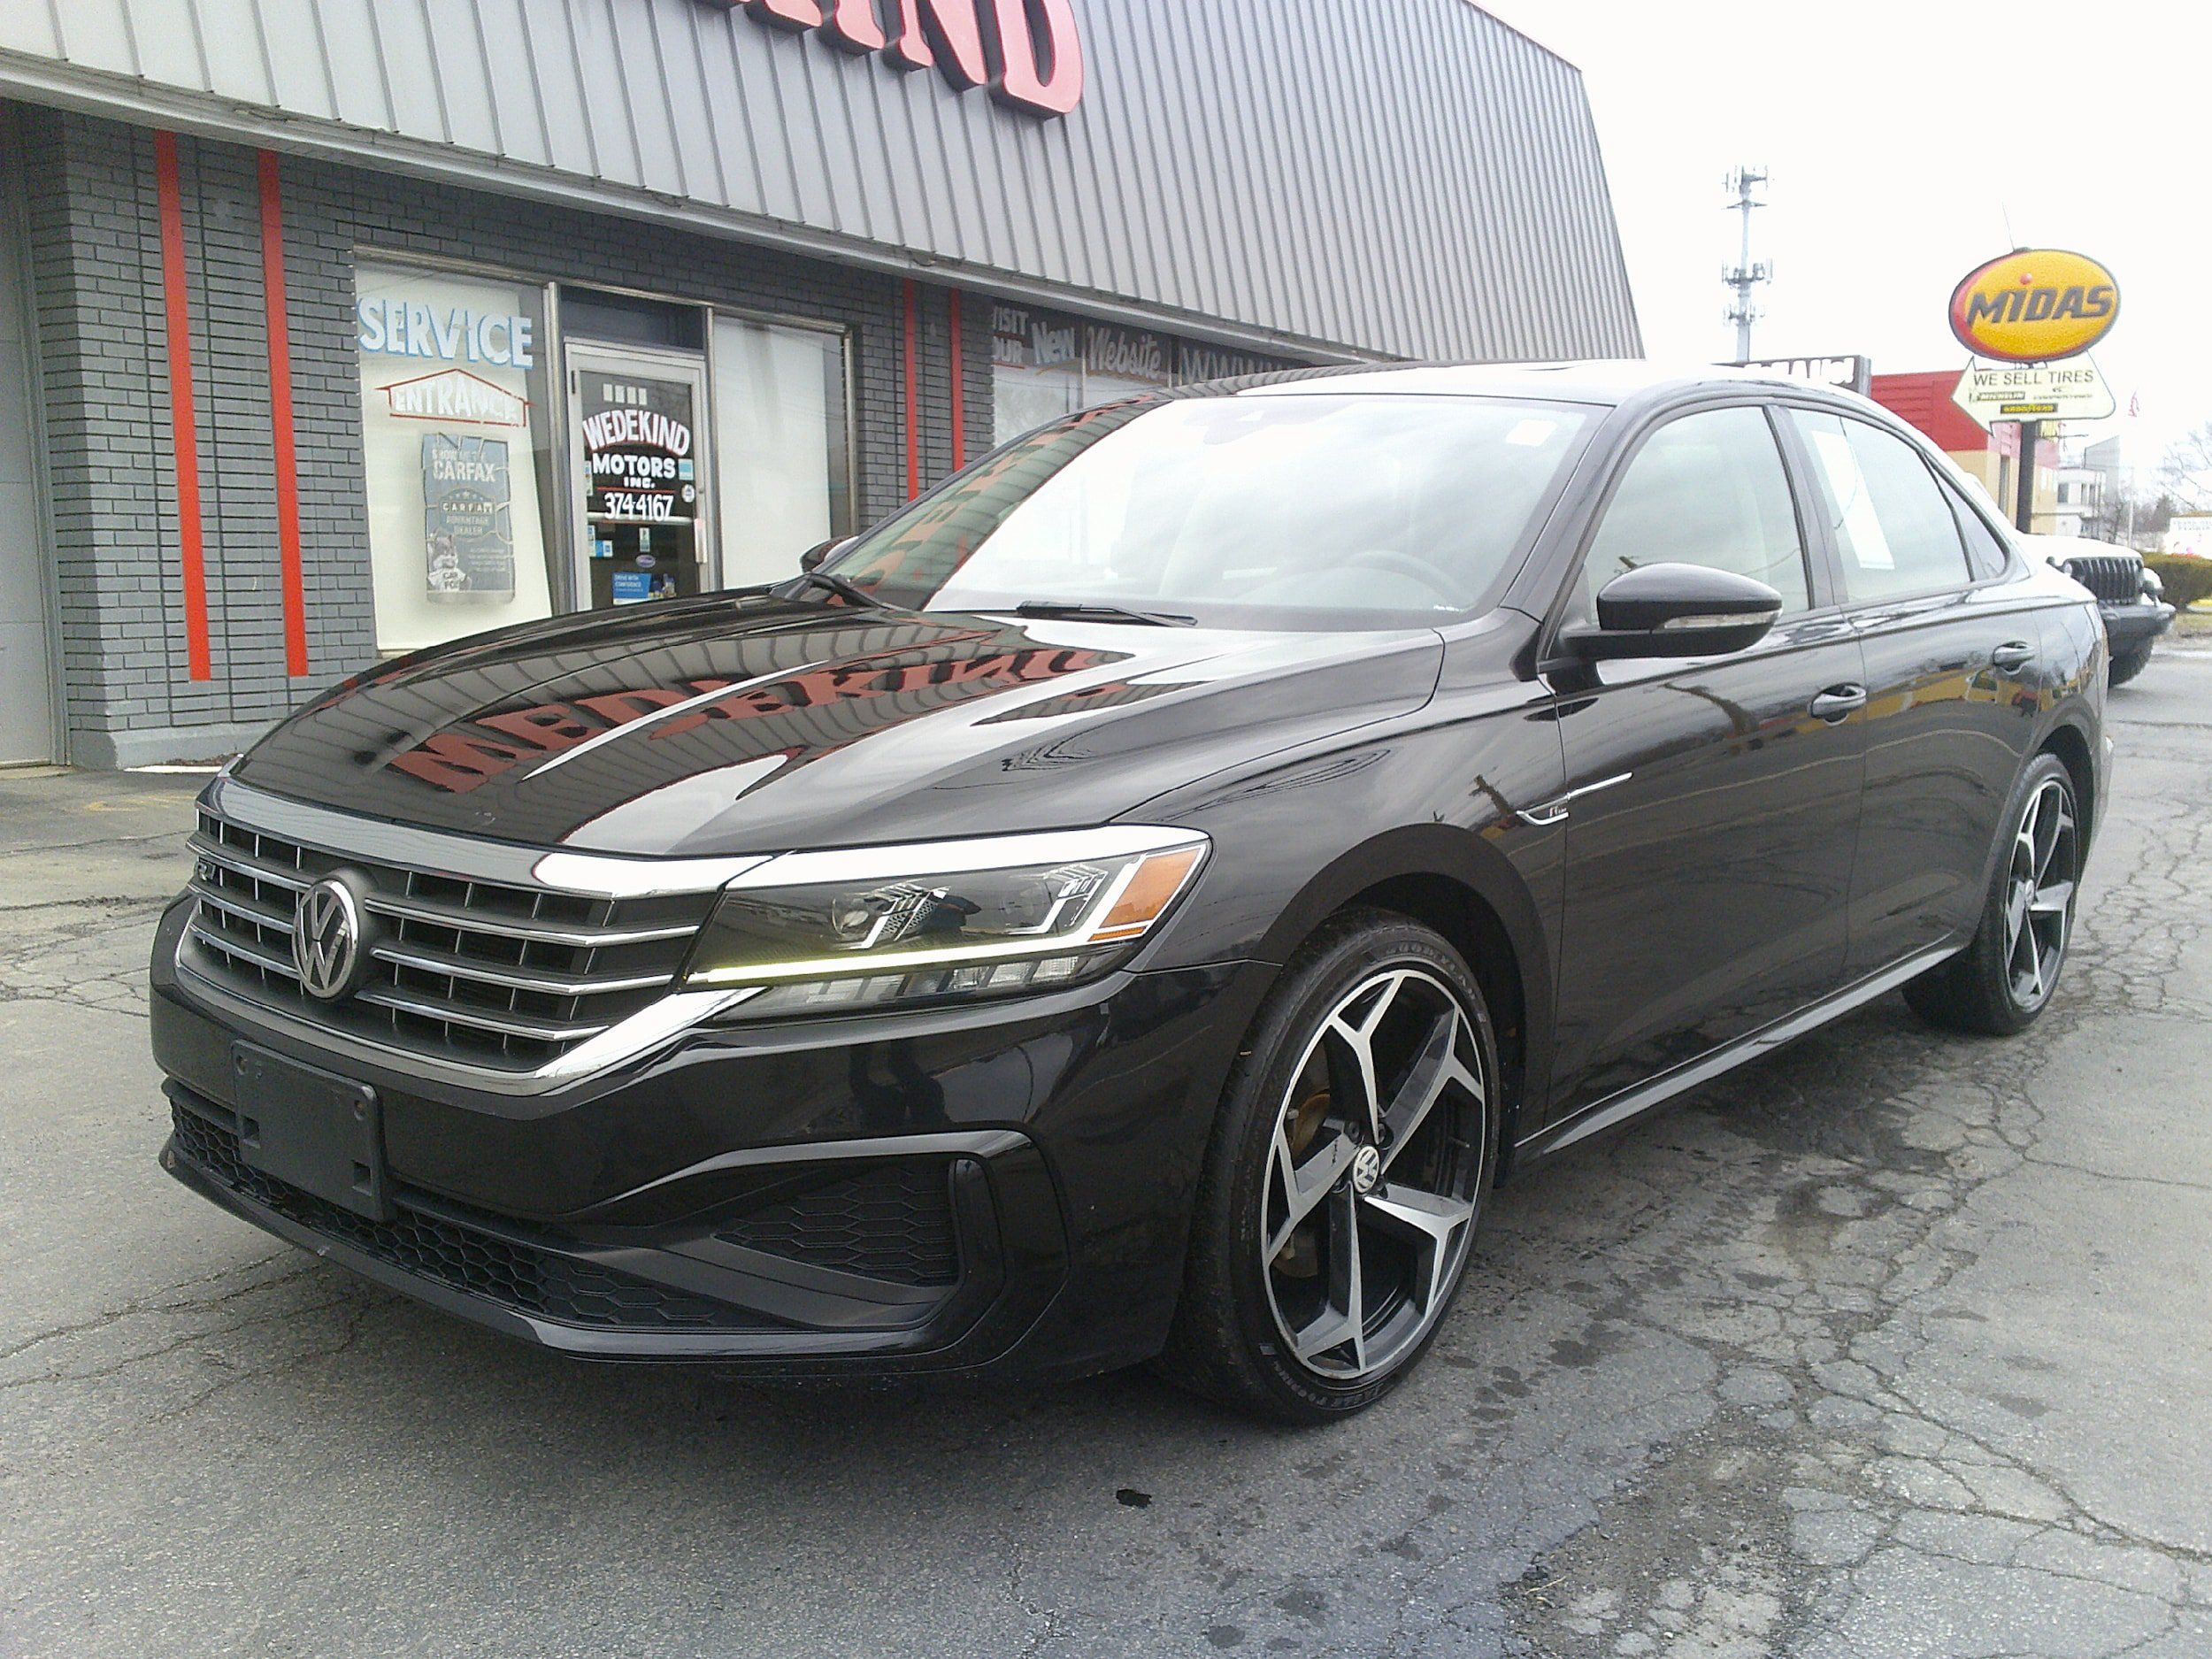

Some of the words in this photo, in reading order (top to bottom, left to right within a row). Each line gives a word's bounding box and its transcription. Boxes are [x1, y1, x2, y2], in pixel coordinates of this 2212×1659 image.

[1967, 275, 2114, 326] MIDAS
[357, 297, 533, 370] SERVICE
[1032, 321, 1076, 365] New
[1087, 326, 1162, 380] Website
[394, 373, 519, 420] ENTRANCE
[1973, 373, 1997, 387] WE
[2003, 373, 2042, 386] SELL
[2048, 370, 2093, 383] TIRES
[582, 409, 690, 457] WEDEKIND
[433, 460, 495, 483] CARFAX
[592, 452, 676, 480] MOTORS
[603, 492, 674, 522] 374-4167
